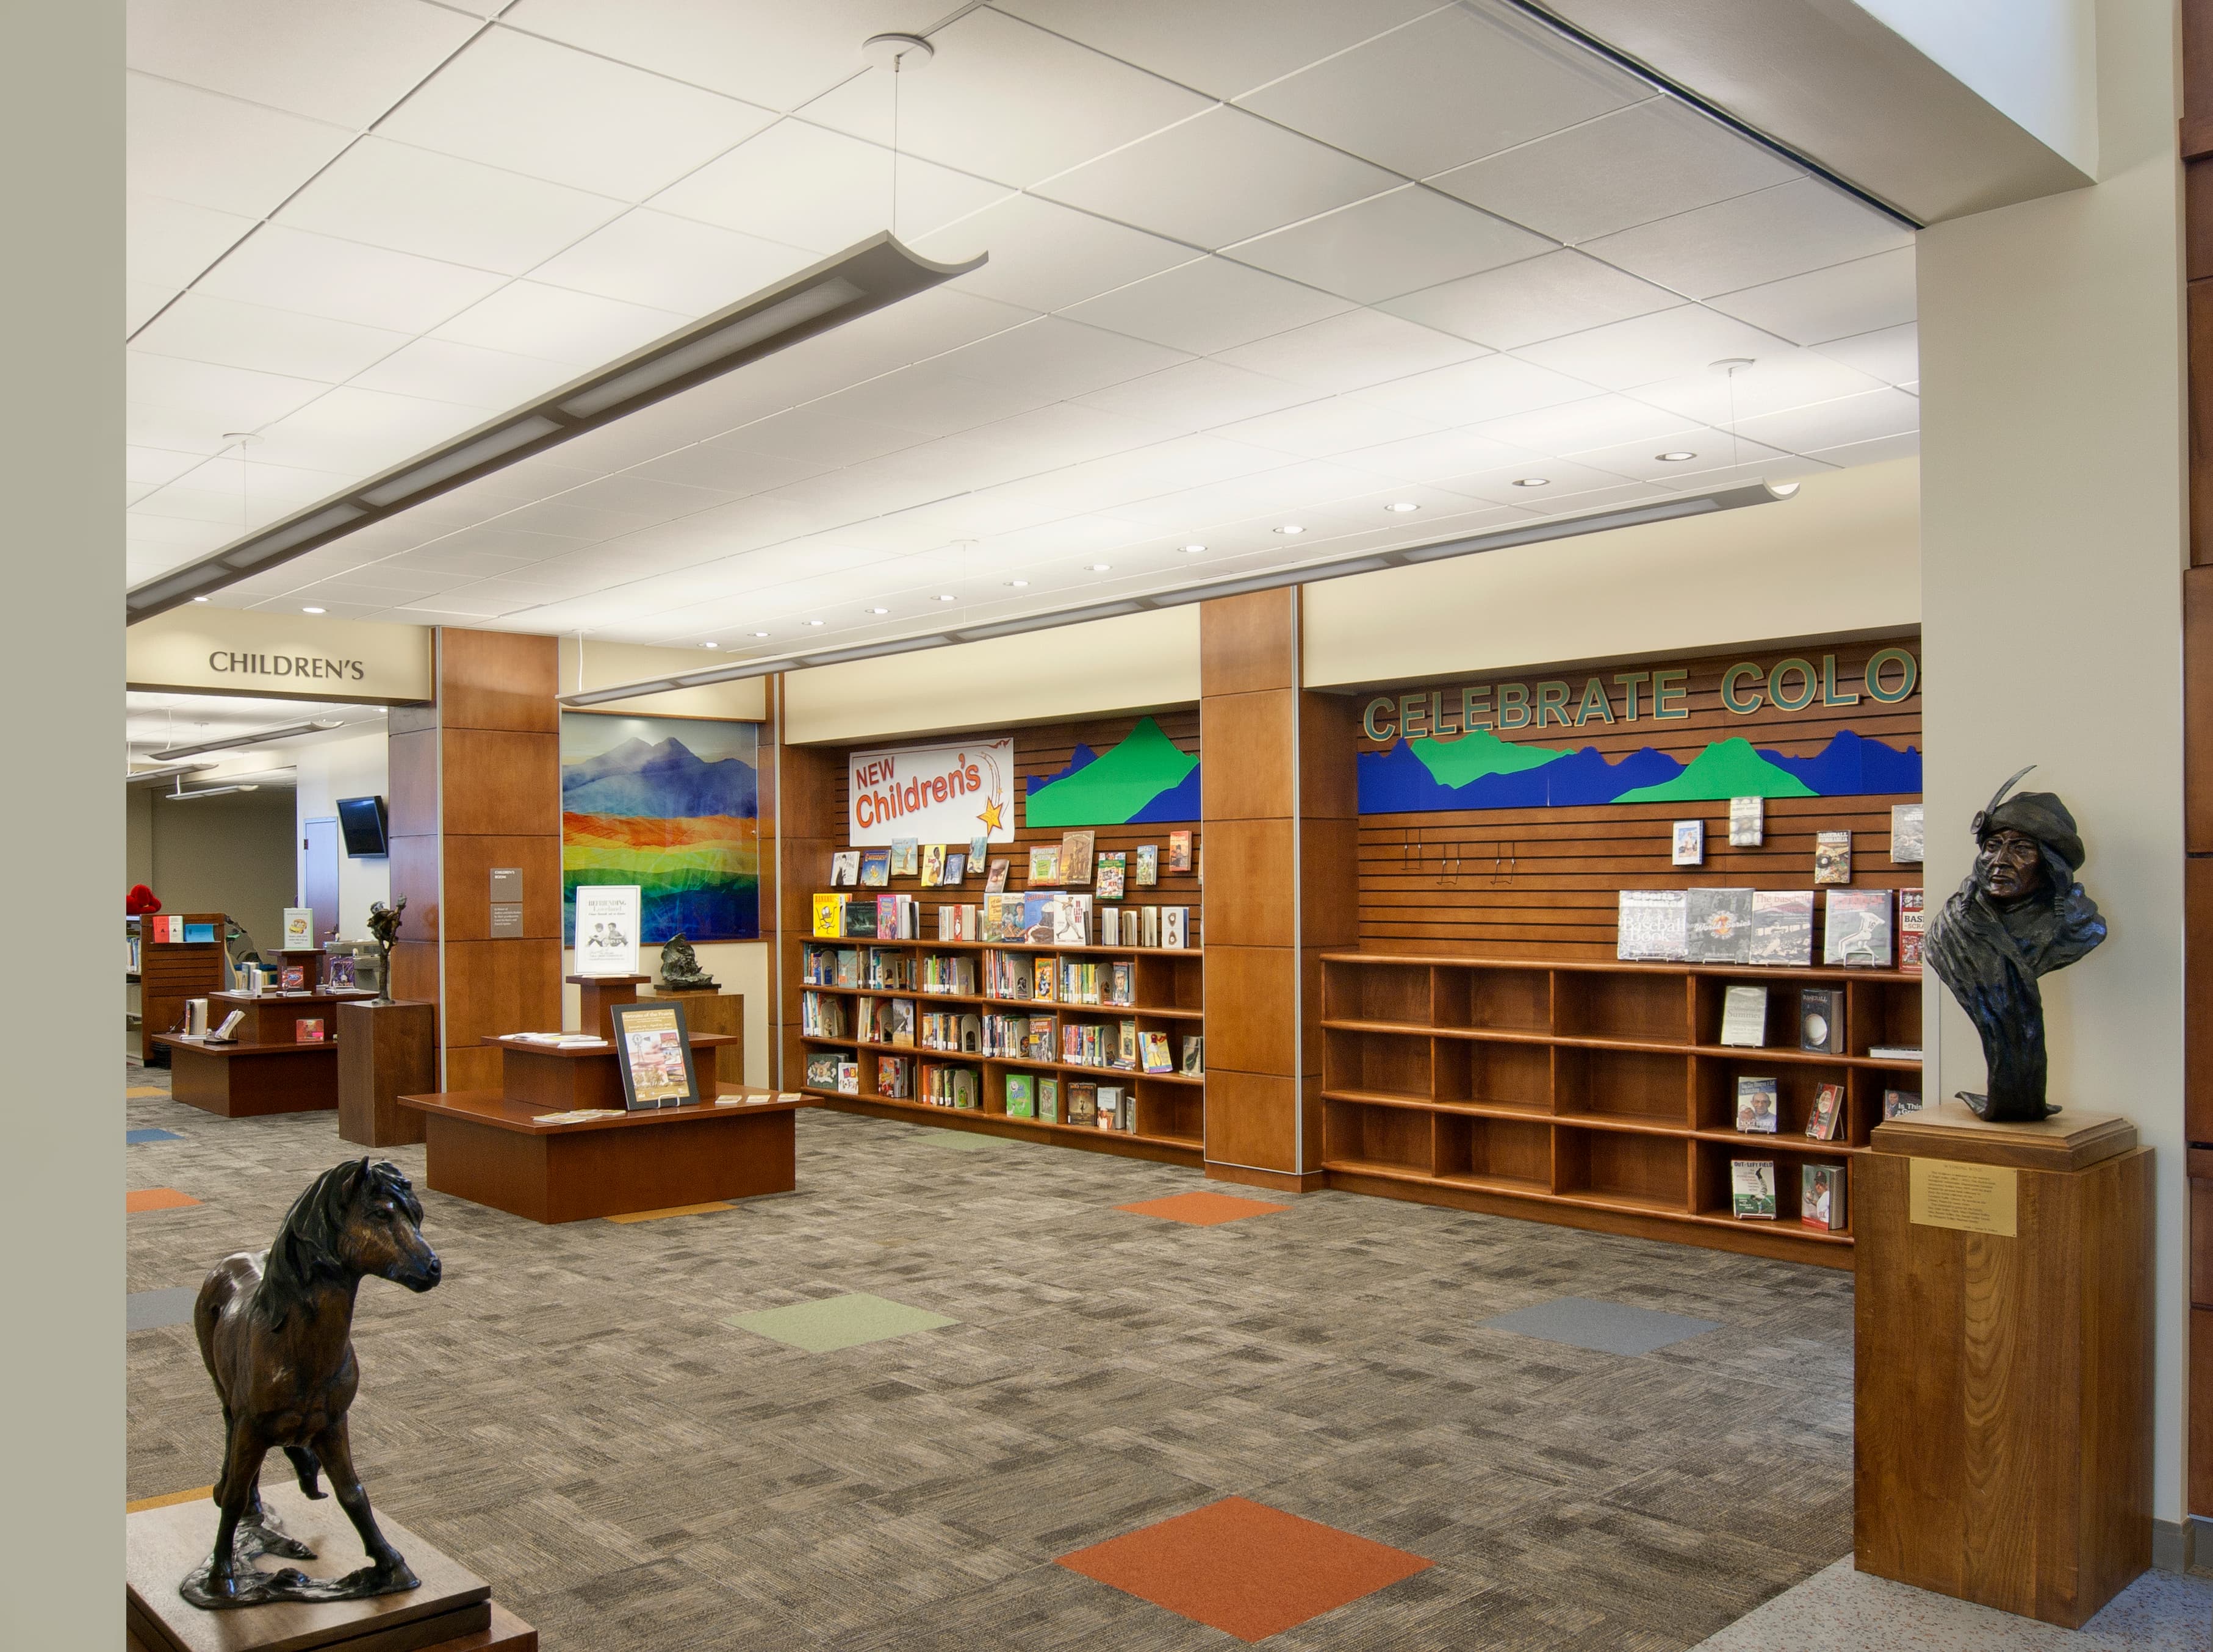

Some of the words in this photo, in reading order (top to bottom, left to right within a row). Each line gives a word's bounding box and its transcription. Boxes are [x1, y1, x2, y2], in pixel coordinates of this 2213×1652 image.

[209, 650, 365, 680] CHILDREN'S
[1363, 668, 1690, 742] CELEBRATE
[1720, 647, 1918, 715] COLO
[856, 756, 894, 790] NEW
[856, 753, 981, 828] Children's
[1756, 894, 1772, 903] The
[1622, 916, 1686, 932] Baseball
[1694, 921, 1722, 932] World
[1630, 930, 1670, 942] Book
[1727, 1010, 1760, 1019] Summer
